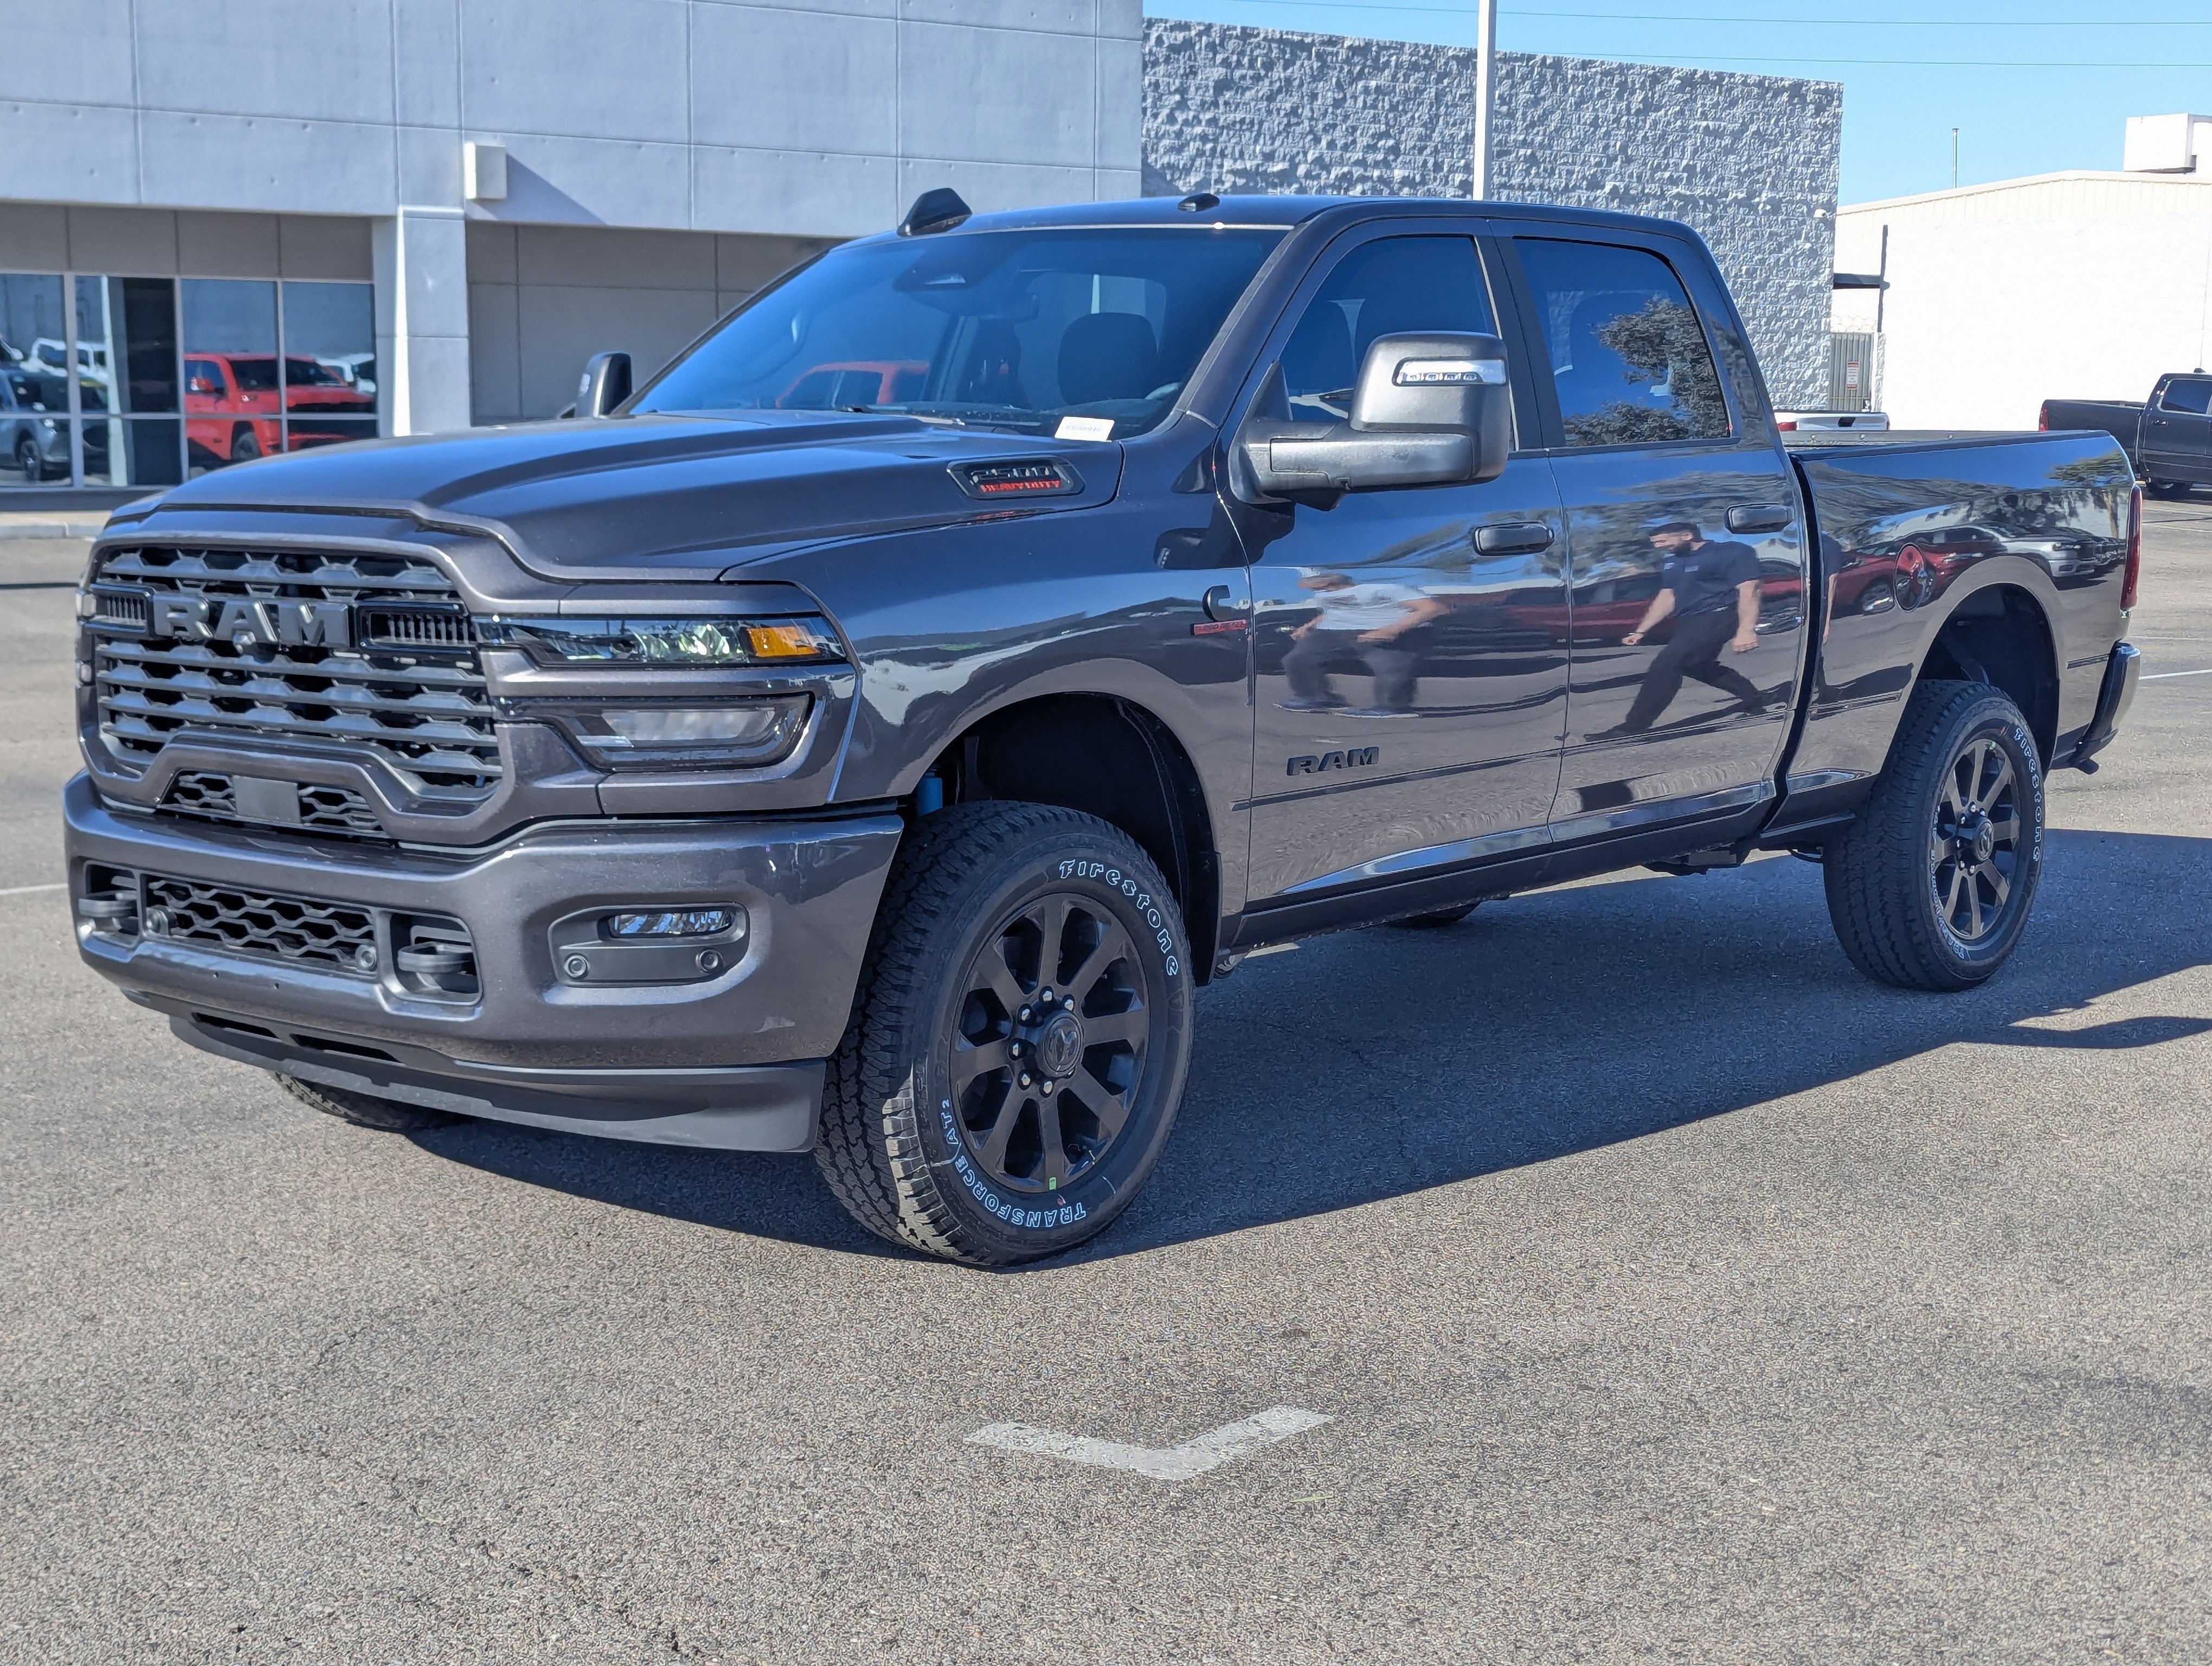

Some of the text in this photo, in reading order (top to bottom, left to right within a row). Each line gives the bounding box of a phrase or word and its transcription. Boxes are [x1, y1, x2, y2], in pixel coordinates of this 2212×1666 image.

[153, 595, 350, 648] RAM
[1287, 746, 1379, 776] RAM
[1059, 859, 1179, 976] Firestone
[941, 1099, 1086, 1228] TRANSFORCE AT2
